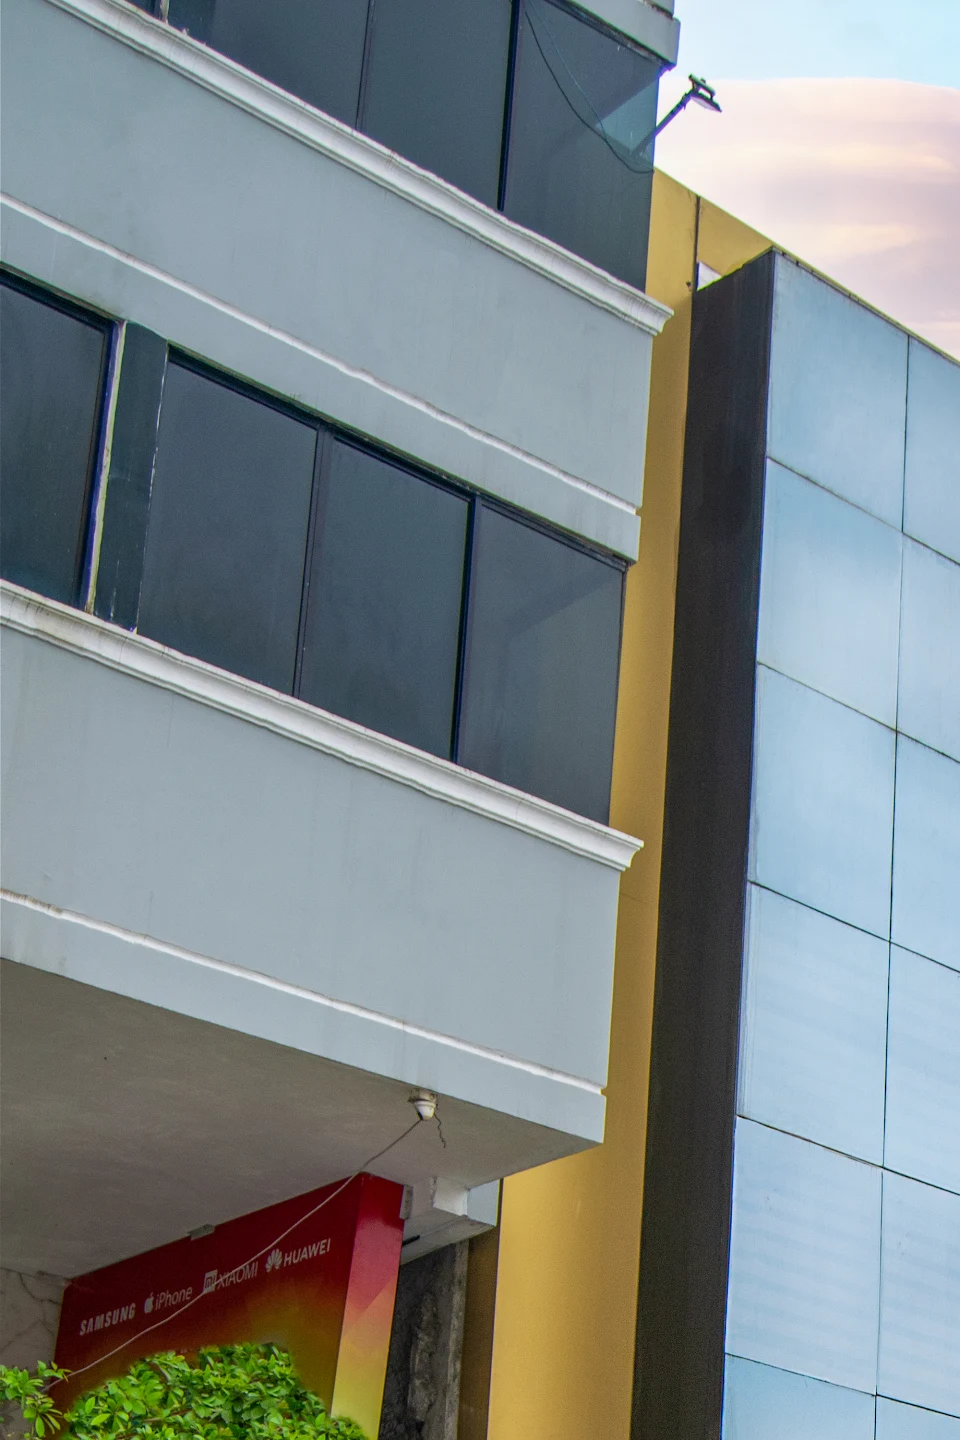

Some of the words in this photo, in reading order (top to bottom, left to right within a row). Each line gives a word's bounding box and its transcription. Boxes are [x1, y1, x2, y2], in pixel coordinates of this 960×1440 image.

[79, 1303, 136, 1336] SAMSUNG
[154, 1286, 193, 1311] iPhone
[217, 1261, 259, 1289] XIAOMI
[283, 1238, 331, 1267] HUAWEI
